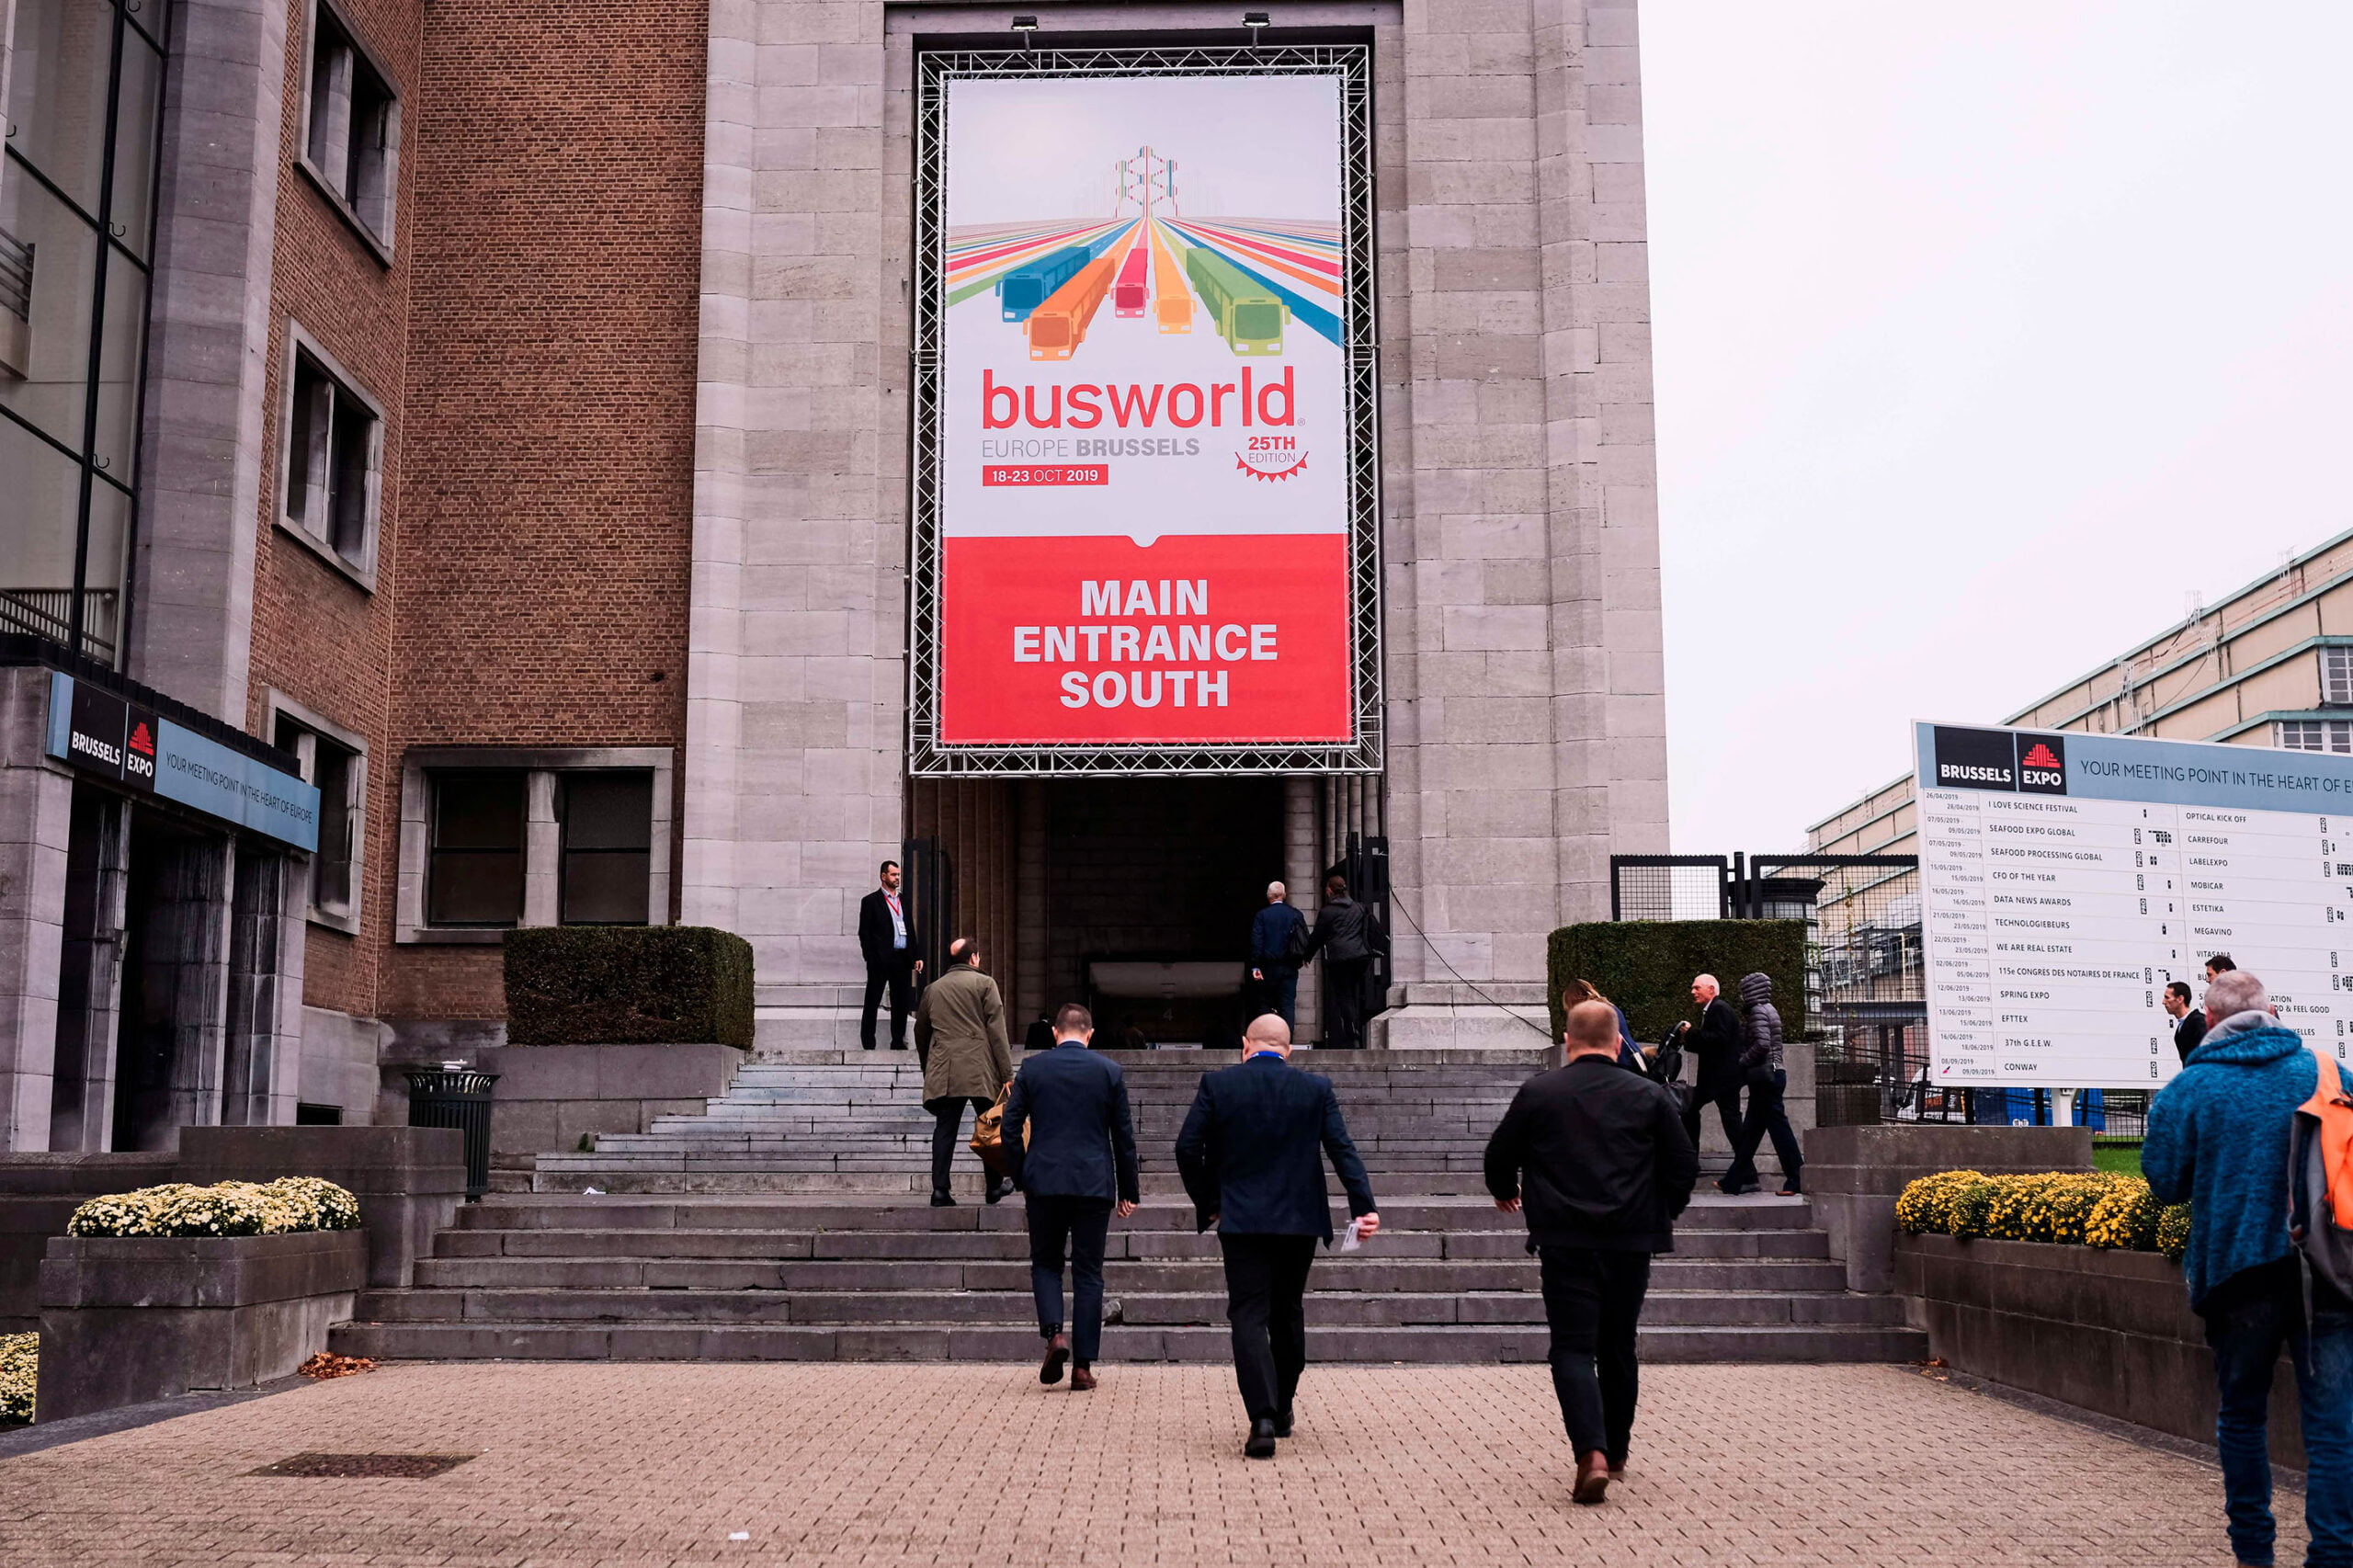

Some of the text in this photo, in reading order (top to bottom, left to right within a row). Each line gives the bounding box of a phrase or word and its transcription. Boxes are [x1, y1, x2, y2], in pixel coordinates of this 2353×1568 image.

[983, 437, 1200, 458] EUROPE BRUSSELS
[1248, 436, 1295, 450] 25TH
[1248, 452, 1296, 463] EDITION
[993, 469, 1099, 483] 18-23 OCT 2019
[1081, 579, 1208, 616] MAIN
[1014, 624, 1278, 662] ENTRANCE
[1060, 670, 1228, 708] SOUTH
[72, 731, 120, 765] BRUSSELS
[127, 754, 153, 778] EXPO
[1940, 764, 2011, 782] BRUSSELS
[2023, 770, 2062, 787] EXPO
[2081, 760, 2353, 793] YOUR MEETING POINT IN THE HEART OF E
[166, 752, 313, 824] YOUR MEETING POINT IN THE HEART OF EUROPE
[2014, 802, 2043, 811] SCIENCE
[2046, 804, 2077, 813] FESTIVAL
[2186, 812, 2214, 822] OPTICAL
[1989, 825, 2075, 836] SEAFOOD EXPO GLOBAL
[2188, 835, 2228, 845] CARREFOUR
[1991, 848, 2025, 857] SEAFOOD
[2028, 849, 2073, 859] PROCESSING
[2191, 881, 2223, 890] MOBICAR
[1994, 895, 2072, 906] DATA NEWS AWARDS
[1995, 919, 2070, 929] TECHNOLOGIEBEURS
[2194, 927, 2232, 936] MEGAVINO
[1996, 943, 2008, 951] WE
[2048, 945, 2072, 953] ESTATE
[1999, 967, 2015, 975] 115e
[2017, 968, 2050, 976] CONGRES
[2068, 970, 2101, 978] NOTAIRES
[2000, 991, 2028, 999] SPRING
[2002, 1015, 2028, 1023] EFTTEX
[2005, 1039, 2021, 1047] 37th
